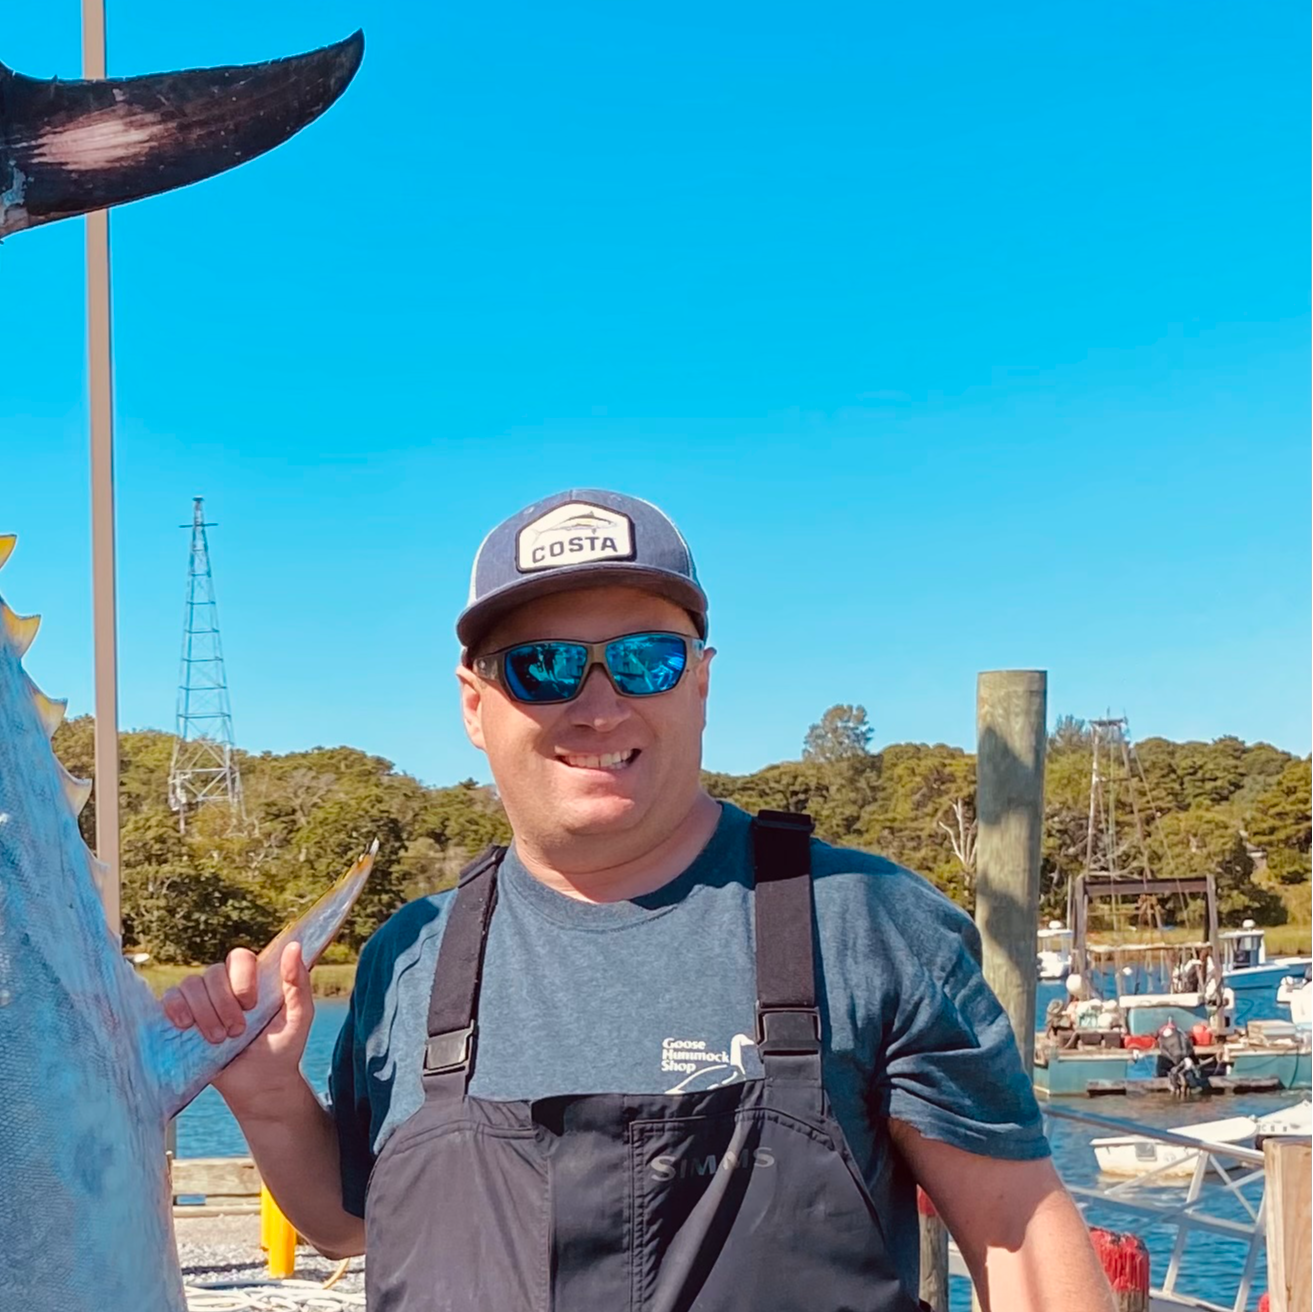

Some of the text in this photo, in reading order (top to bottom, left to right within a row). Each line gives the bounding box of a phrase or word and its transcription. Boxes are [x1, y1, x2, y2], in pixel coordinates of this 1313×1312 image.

[531, 536, 618, 564] COSTA
[662, 1037, 706, 1050] Goose
[662, 1048, 730, 1063] Hummock
[661, 1060, 696, 1074] Shop
